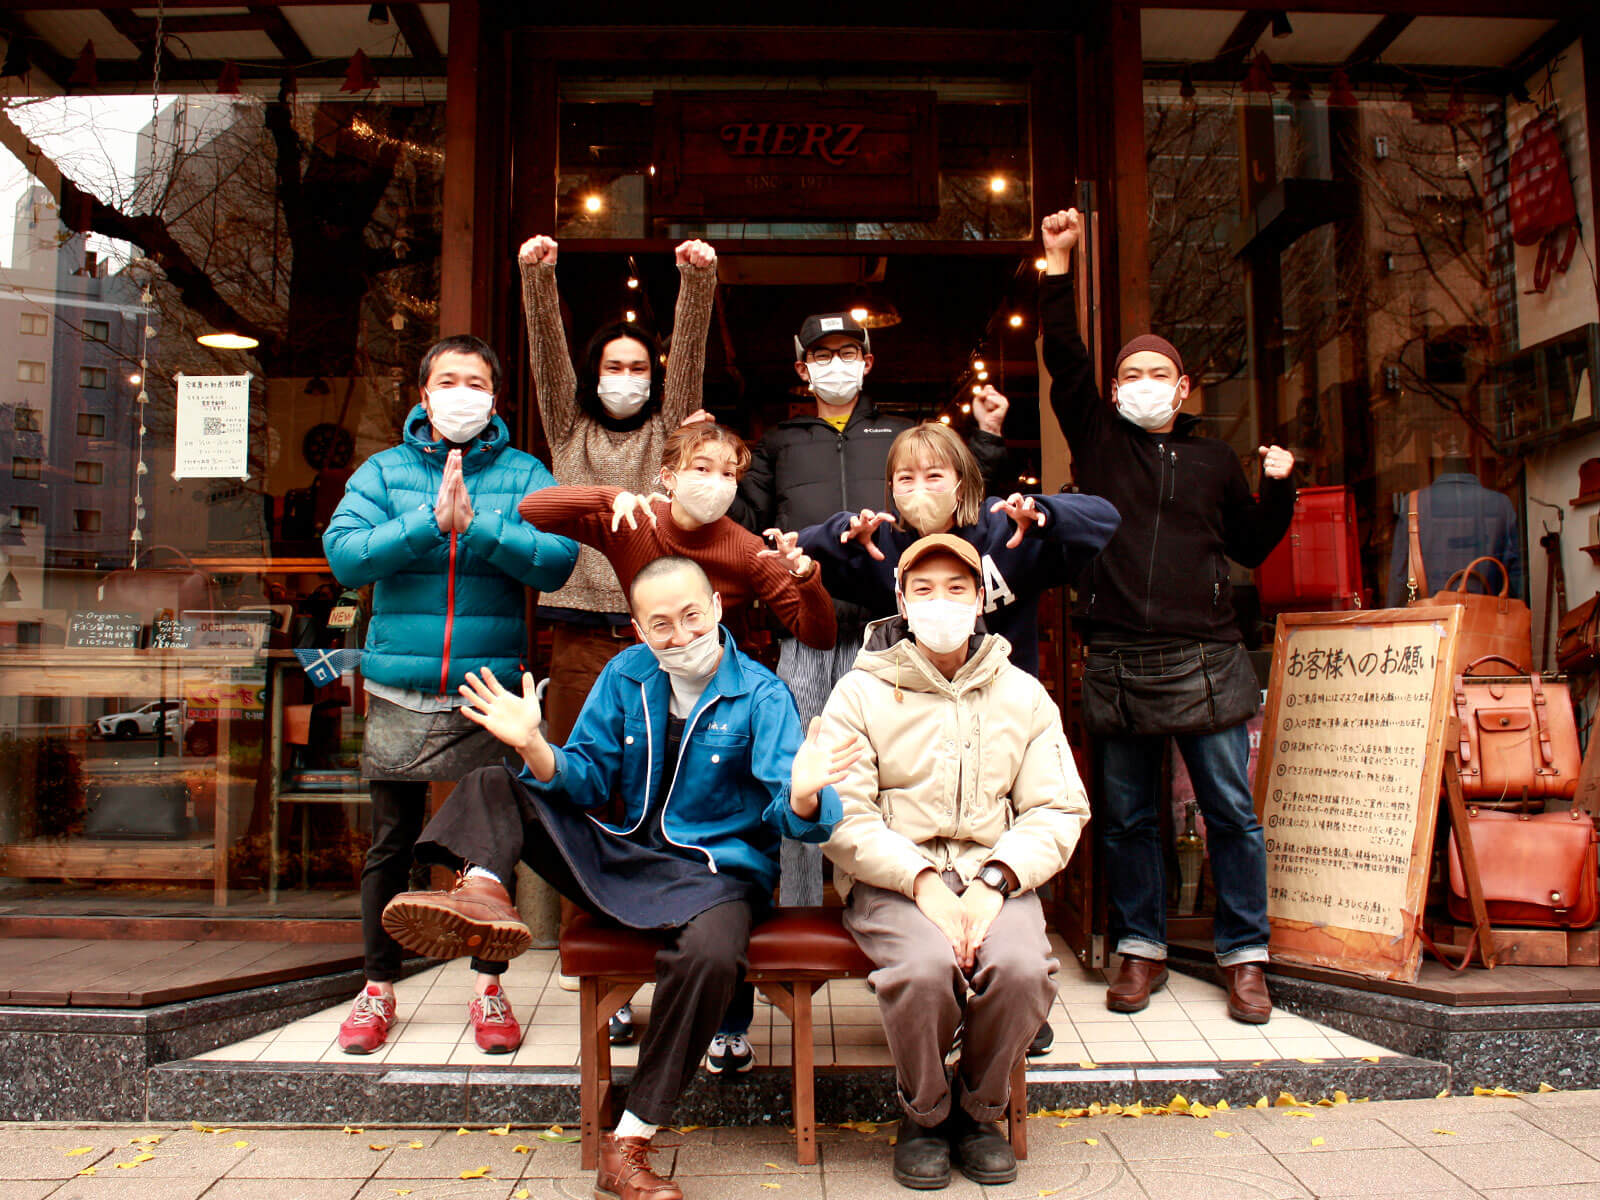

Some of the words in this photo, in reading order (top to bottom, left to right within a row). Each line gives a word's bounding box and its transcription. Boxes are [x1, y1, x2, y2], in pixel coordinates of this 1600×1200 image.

[720, 122, 864, 165] HERZ
[981, 554, 1016, 614] A
[331, 611, 353, 622] NEW
[1287, 644, 1435, 680] お客様へのお願い
